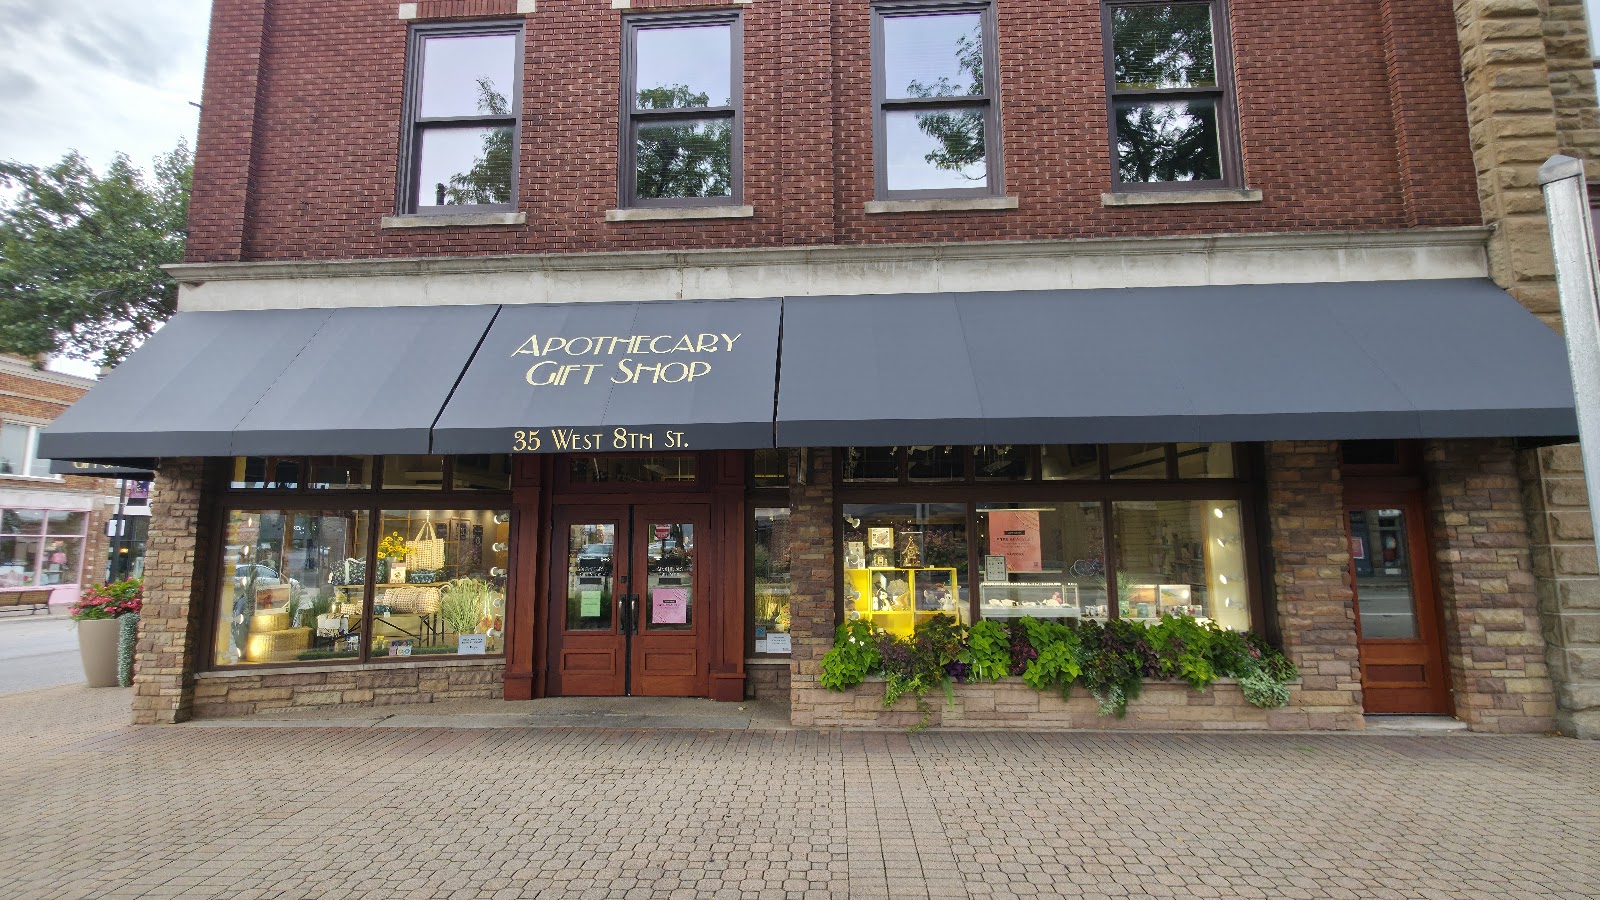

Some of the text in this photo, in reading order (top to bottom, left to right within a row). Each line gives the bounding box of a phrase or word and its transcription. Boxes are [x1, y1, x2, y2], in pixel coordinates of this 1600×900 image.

[511, 333, 742, 357] APOTHECARY
[525, 358, 712, 386] GIFT SHOP
[512, 427, 690, 452] 35 WEST 8TH ST.
